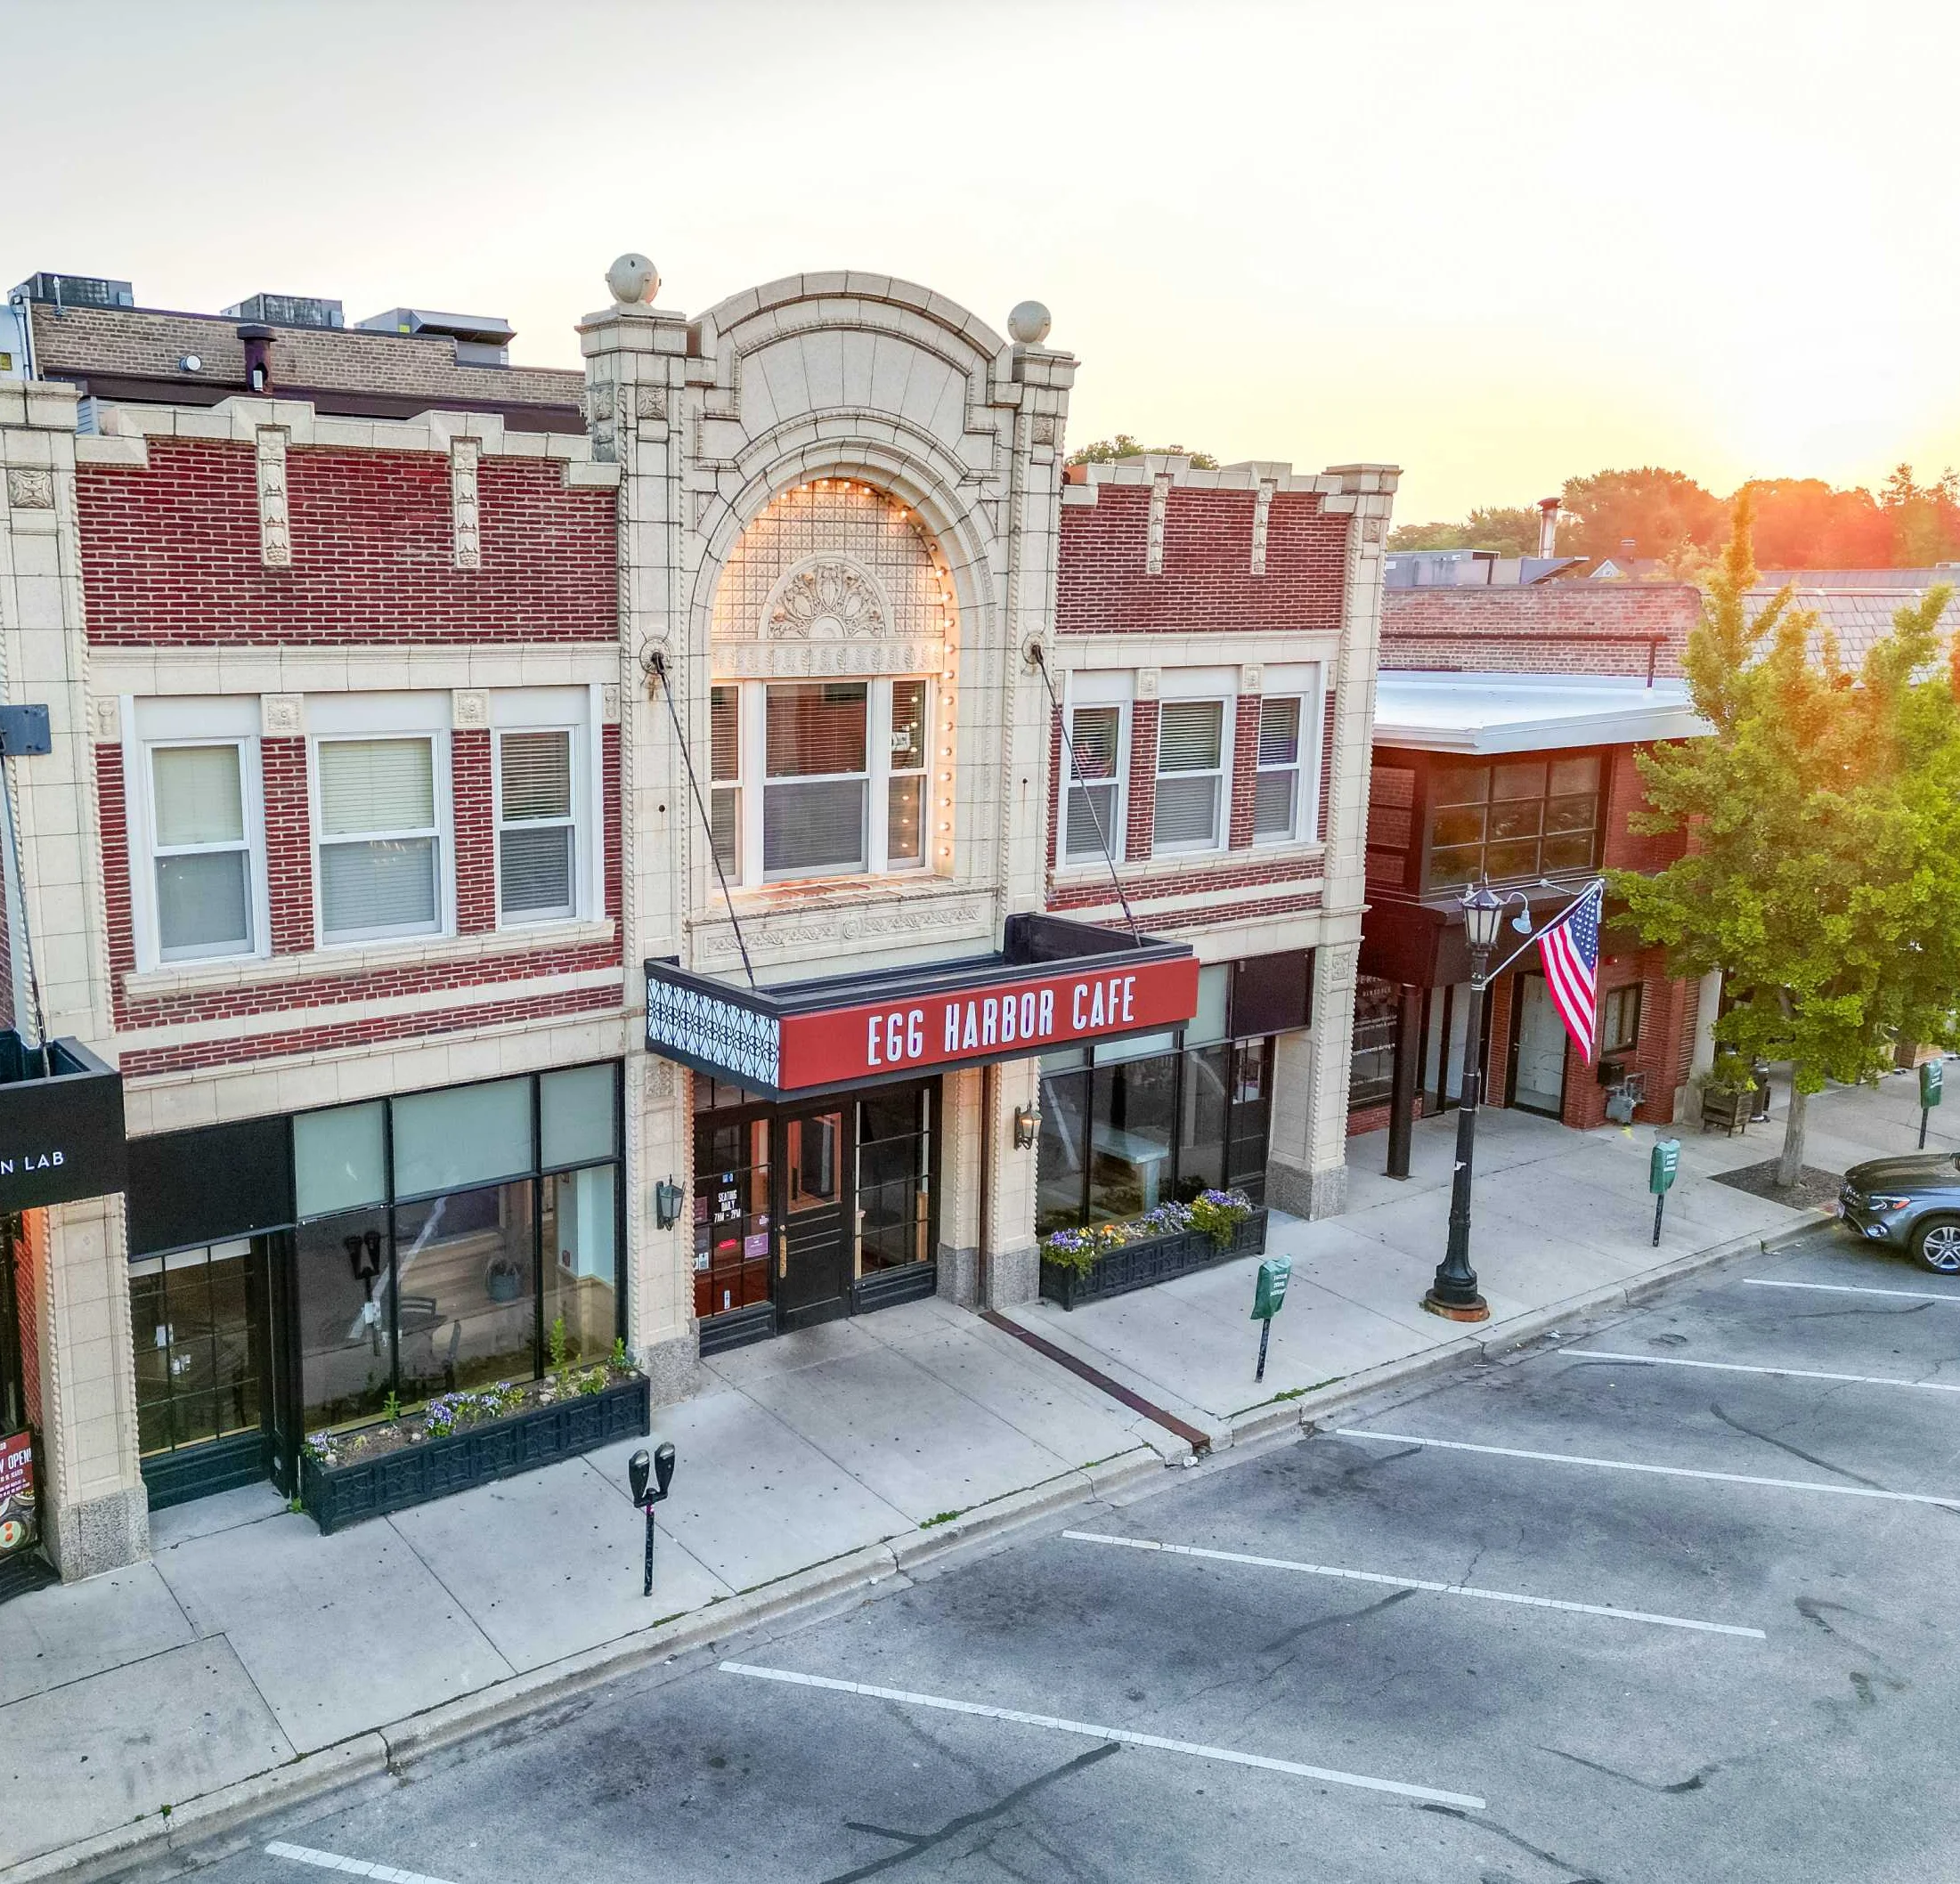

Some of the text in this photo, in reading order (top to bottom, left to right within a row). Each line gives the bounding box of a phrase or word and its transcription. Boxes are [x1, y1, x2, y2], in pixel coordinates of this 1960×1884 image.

[867, 977, 1136, 1066] EGG HARBOR CAFE
[25, 1151, 64, 1171] LAB
[721, 1200, 736, 1212] DAILY
[714, 1212, 725, 1223] 7AM
[8, 1447, 32, 1469] OPEN!
